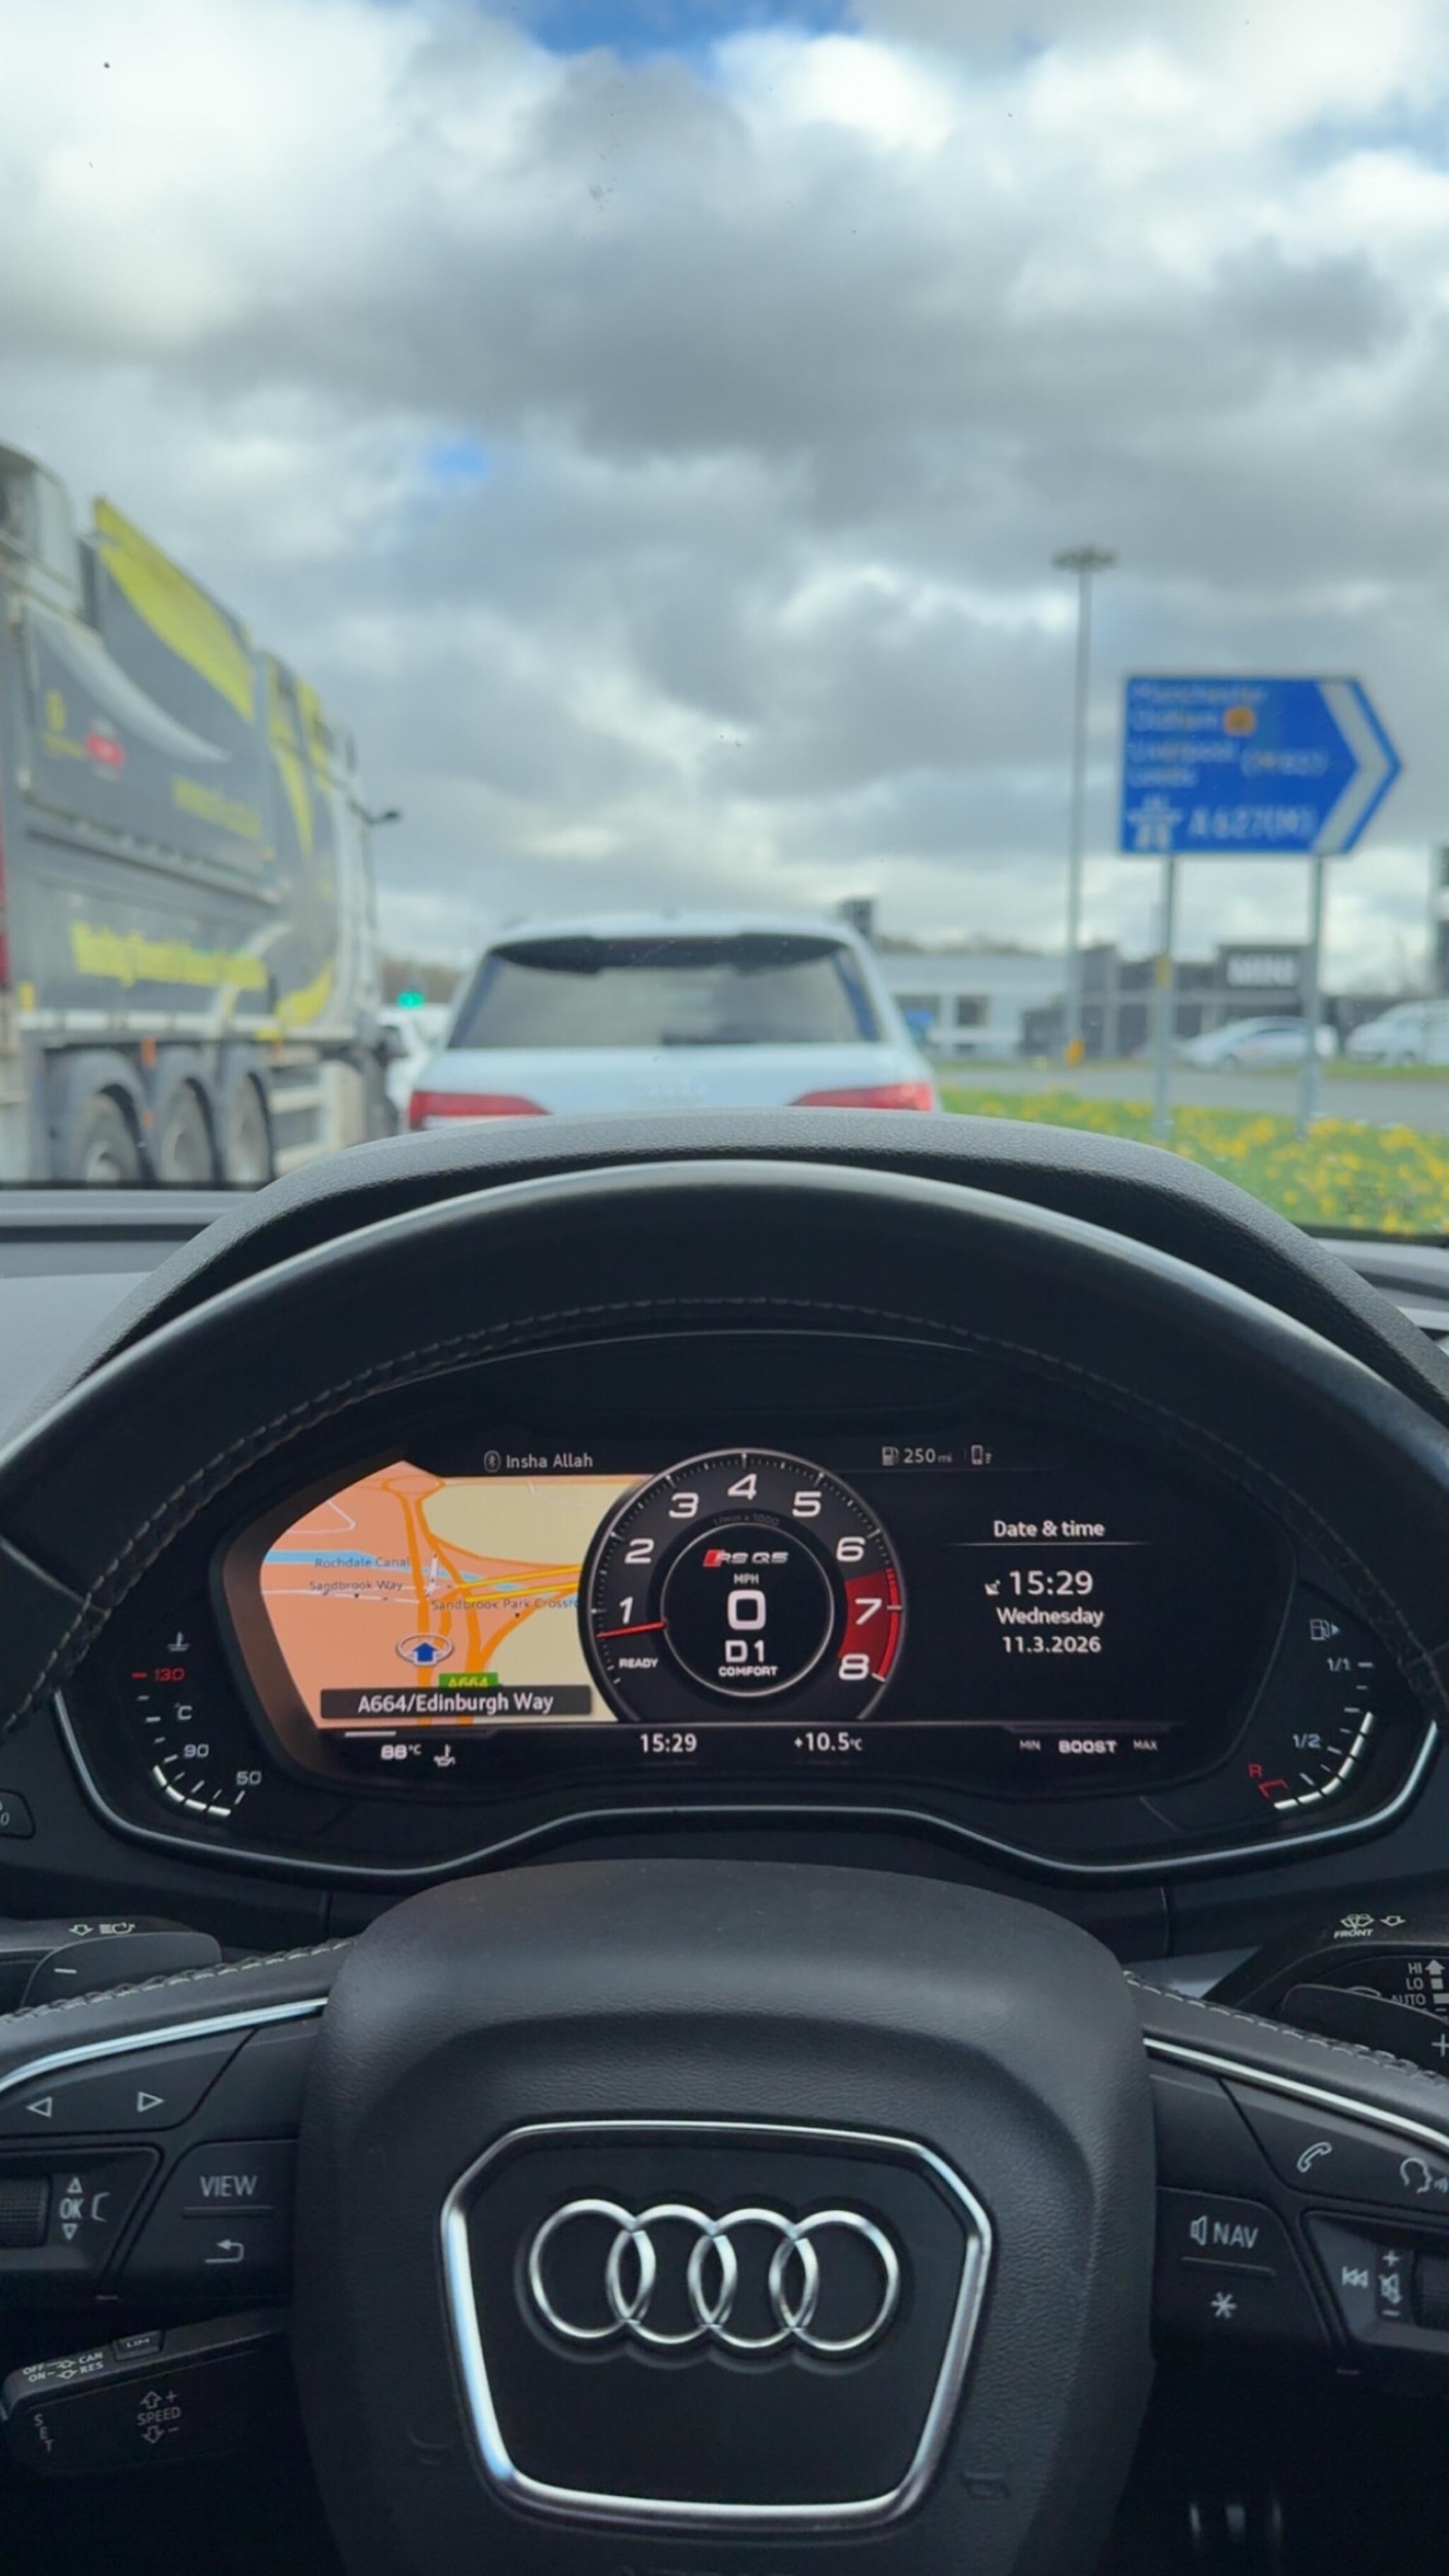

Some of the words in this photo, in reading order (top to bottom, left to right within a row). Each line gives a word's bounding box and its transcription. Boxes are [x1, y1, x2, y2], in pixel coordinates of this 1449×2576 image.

[506, 1454, 548, 1469] Insha
[554, 1453, 593, 1469] Allah
[727, 1474, 756, 1500] 4
[669, 1493, 698, 1518] 3
[792, 1492, 822, 1517] 5
[993, 1520, 1037, 1536] Date
[1042, 1521, 1058, 1536] &
[1061, 1520, 1105, 1536] time
[625, 1538, 654, 1564] 2
[837, 1536, 865, 1562] 6
[315, 1556, 374, 1567] Rochdale
[376, 1557, 411, 1567] Canal
[309, 1580, 373, 1591] Sandbrook
[377, 1581, 403, 1592] Way
[734, 1574, 759, 1585] MPH
[1009, 1570, 1094, 1595] 15:29
[431, 1598, 497, 1611] Sandbrook
[503, 1597, 531, 1610] Park
[619, 1596, 634, 1623] 1
[727, 1590, 766, 1630] 0
[856, 1598, 882, 1625] 7
[996, 1607, 1104, 1627] Wednesday
[1003, 1636, 1101, 1653] 11.3.2026
[619, 1658, 659, 1669] READY
[838, 1654, 870, 1680] 8
[1327, 1657, 1350, 1672] 1/1
[155, 1669, 185, 1681] 130
[718, 1666, 779, 1677] COMFORT
[358, 1694, 509, 1715] A664/Edinburgh
[514, 1694, 554, 1715] Way
[640, 1734, 696, 1752] 15:29
[1019, 1740, 1040, 1751] MIN
[1059, 1740, 1117, 1754] BOOST
[1133, 1740, 1157, 1751] MAX
[1293, 1734, 1320, 1749] 1/2
[184, 1744, 209, 1758] 90
[1248, 1763, 1262, 1777] R
[236, 1771, 262, 1786] 50
[1333, 1929, 1374, 1939] FRONT
[1407, 1962, 1423, 1974] HI
[1406, 1978, 1424, 1990] LO
[201, 2176, 257, 2197] VIEW
[59, 2198, 84, 2219] OK
[1213, 2221, 1259, 2248] NAV
[78, 2352, 103, 2364] CAN
[22, 2364, 44, 2375] OFF
[80, 2361, 104, 2374] RES
[29, 2372, 45, 2383] ON
[137, 2404, 181, 2426] SPEED
